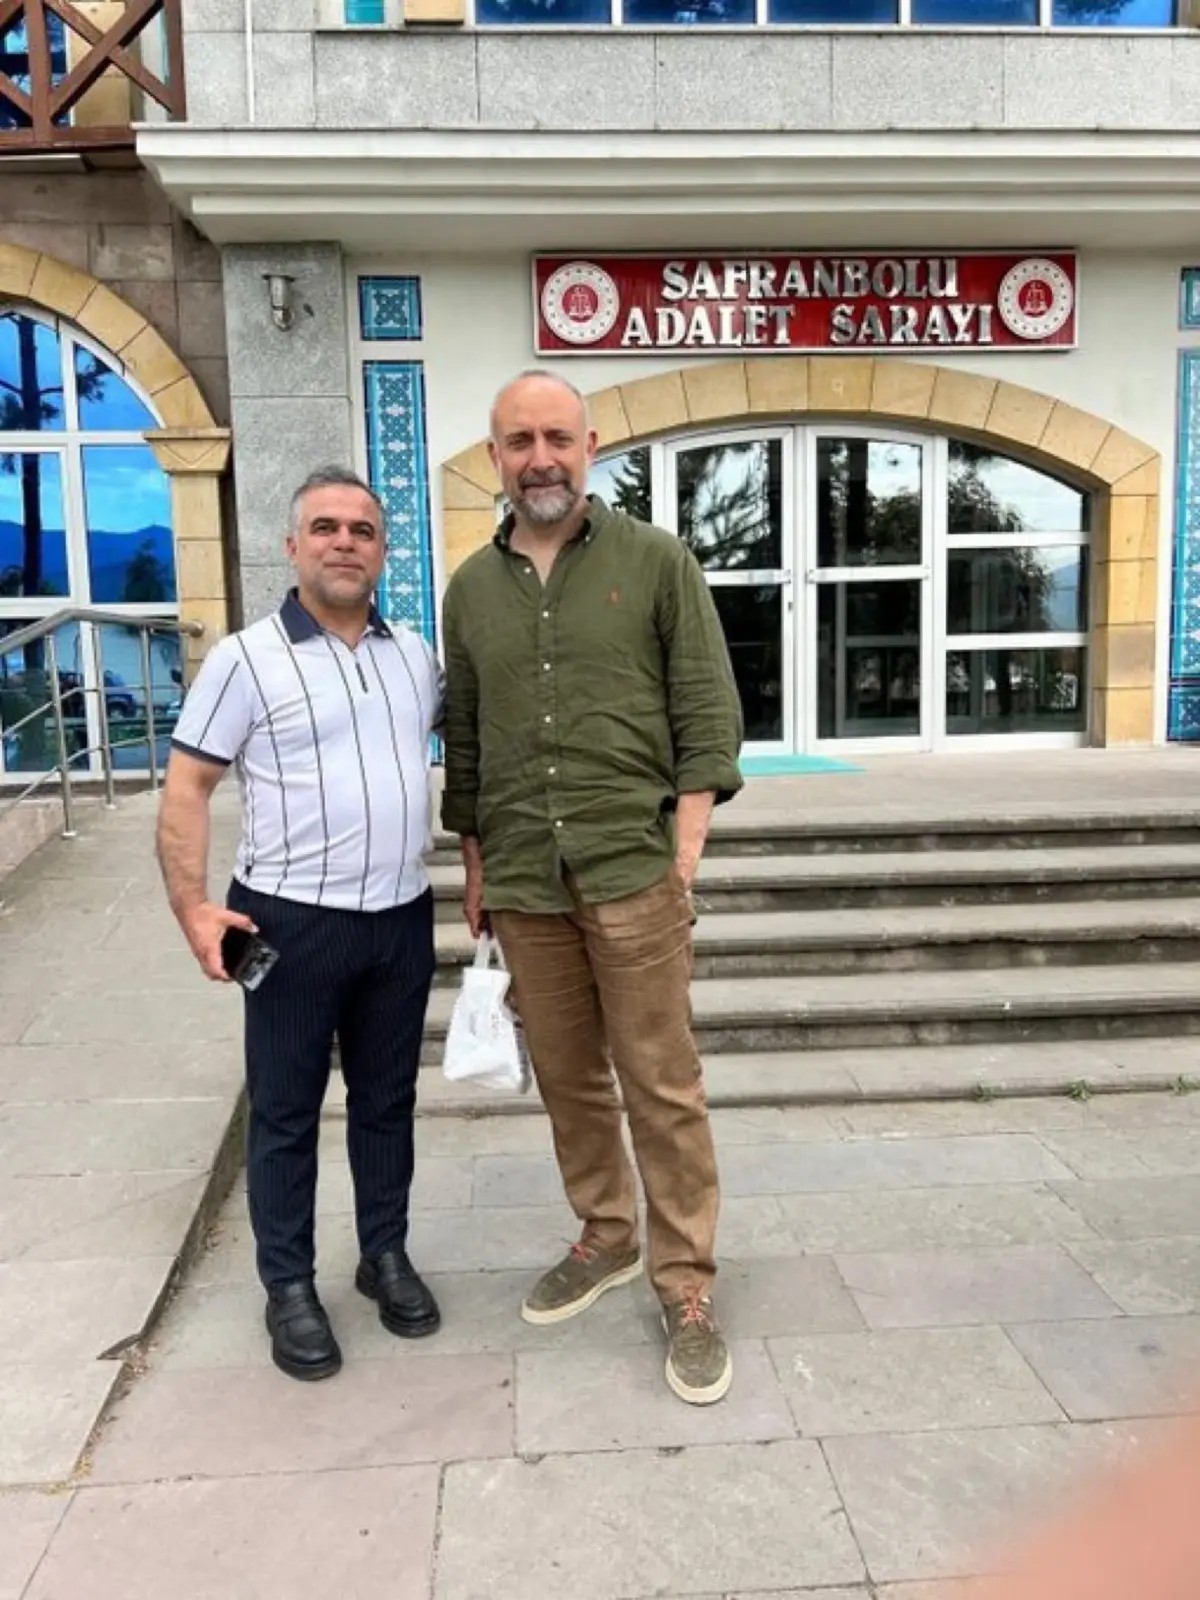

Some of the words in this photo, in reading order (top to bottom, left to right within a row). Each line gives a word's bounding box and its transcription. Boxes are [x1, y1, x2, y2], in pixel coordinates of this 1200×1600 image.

[661, 259, 959, 301] SAFRANBOLU
[620, 304, 796, 347] ADALET
[830, 303, 993, 345] SARAYI
